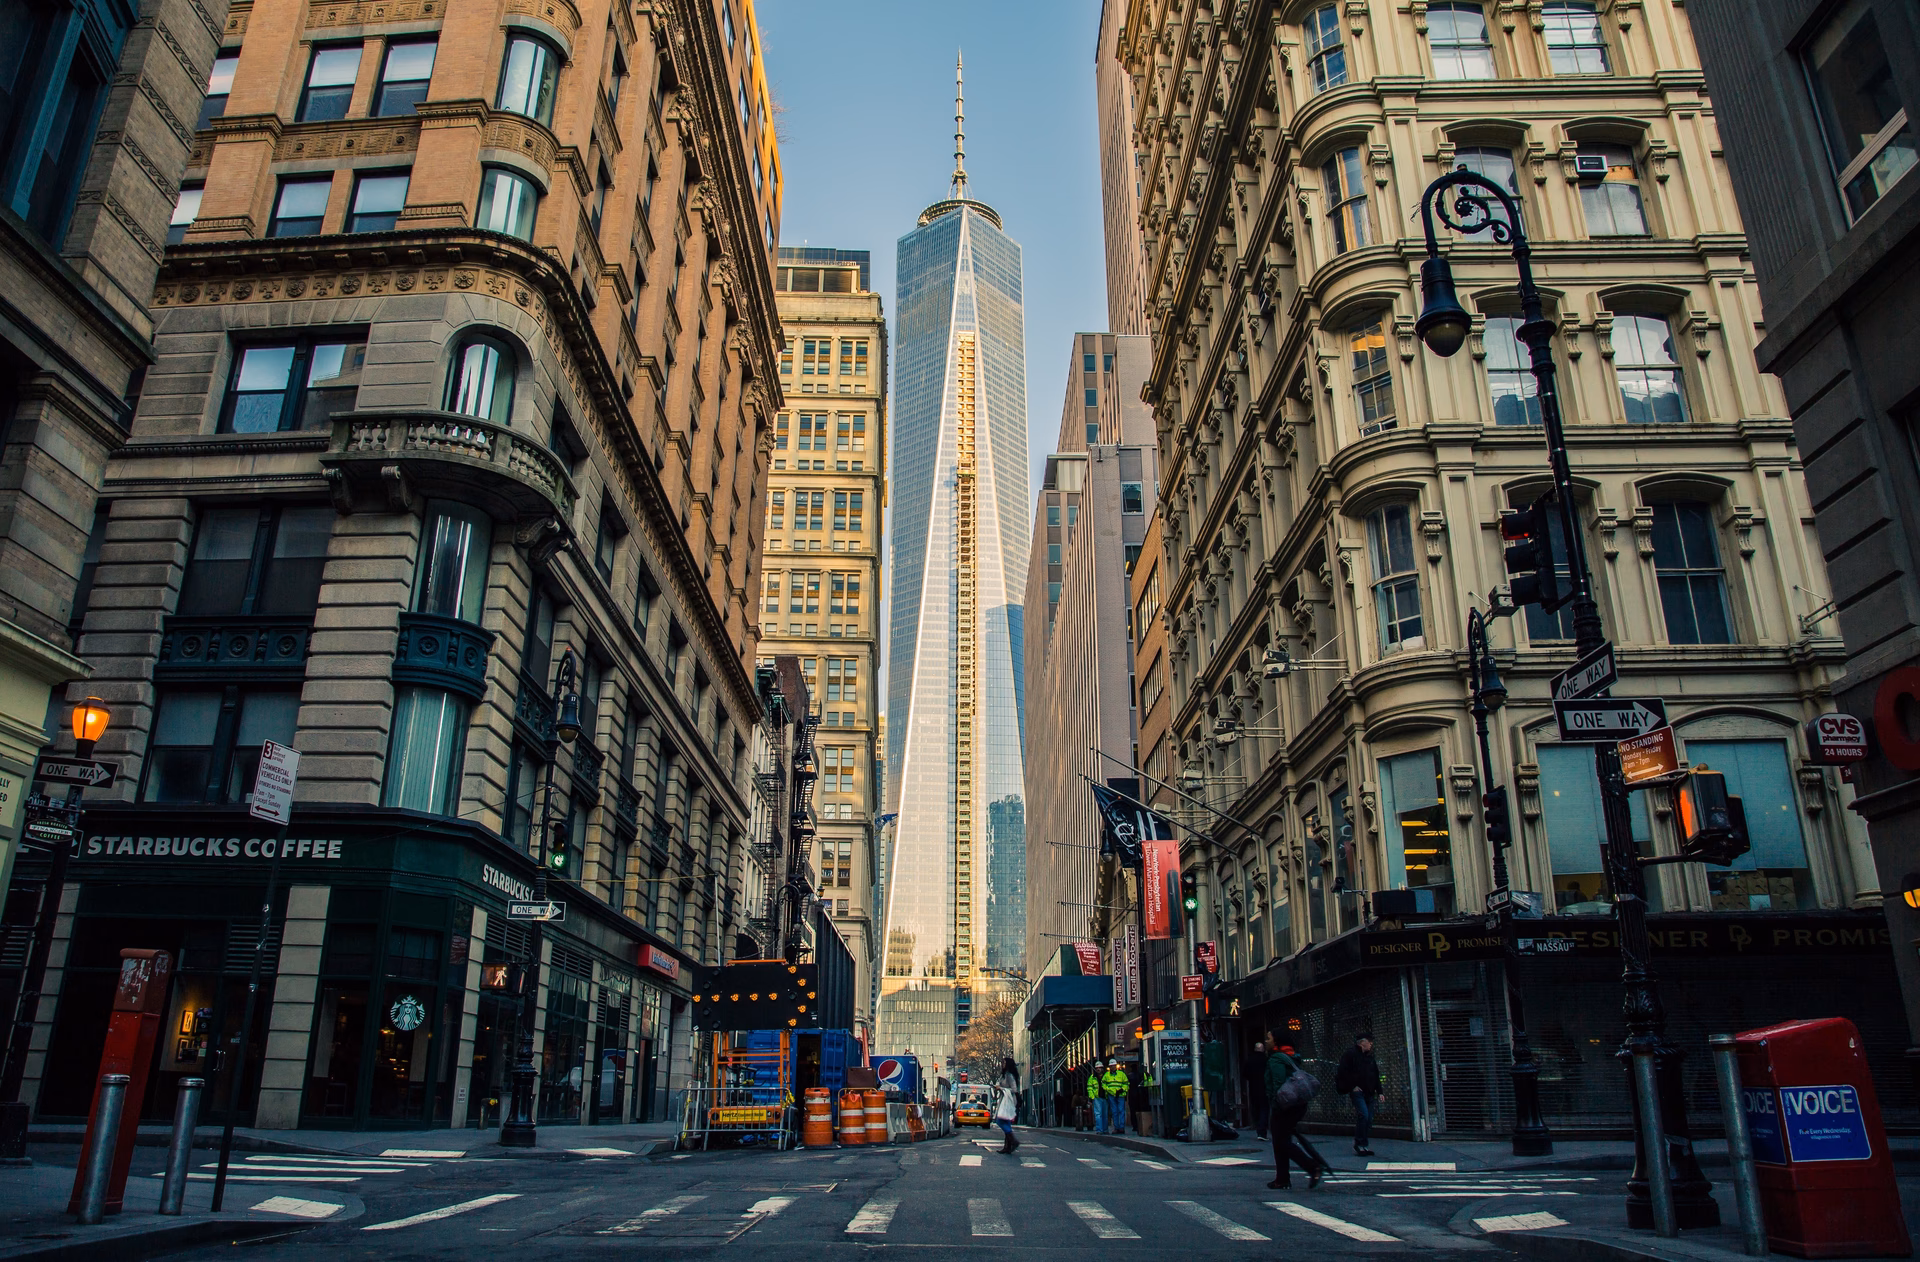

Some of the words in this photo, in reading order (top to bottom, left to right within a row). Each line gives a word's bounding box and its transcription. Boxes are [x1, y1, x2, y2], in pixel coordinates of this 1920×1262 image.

[1561, 677, 1580, 700] ONE
[1585, 660, 1606, 685] WAY
[1573, 712, 1606, 728] ONE
[1618, 711, 1649, 728] WAY
[1819, 718, 1860, 735] CVS
[1620, 742, 1631, 753] NO
[1632, 733, 1664, 750] STANDING
[1822, 735, 1861, 743] pharmacy
[264, 742, 272, 758] 3
[1622, 750, 1641, 762] Monday
[1646, 745, 1662, 756] Friday
[1824, 748, 1836, 756] 24
[1836, 748, 1863, 756] HOURS
[262, 762, 290, 778] COMMERCIAL
[1624, 760, 1635, 770] 7am
[1638, 756, 1650, 768] 7pm
[47, 764, 70, 776] ONE
[79, 767, 104, 780] WAY
[261, 770, 280, 783] VEHICLES
[282, 777, 292, 786] ONLY
[1844, 768, 1852, 777] 24
[87, 836, 240, 857] STARBUCKS
[244, 838, 343, 859] COFFEE
[482, 863, 530, 901] STARBUCKS
[516, 906, 532, 914] ONE
[1370, 942, 1422, 955] DESIGNER
[1457, 936, 1504, 949] PROMISE
[1548, 930, 1709, 948] ESINER
[1773, 927, 1892, 947] PROMIS
[1536, 942, 1570, 952] NASSAU
[1744, 1092, 1776, 1114] OICE
[1788, 1090, 1856, 1116] VOICE
